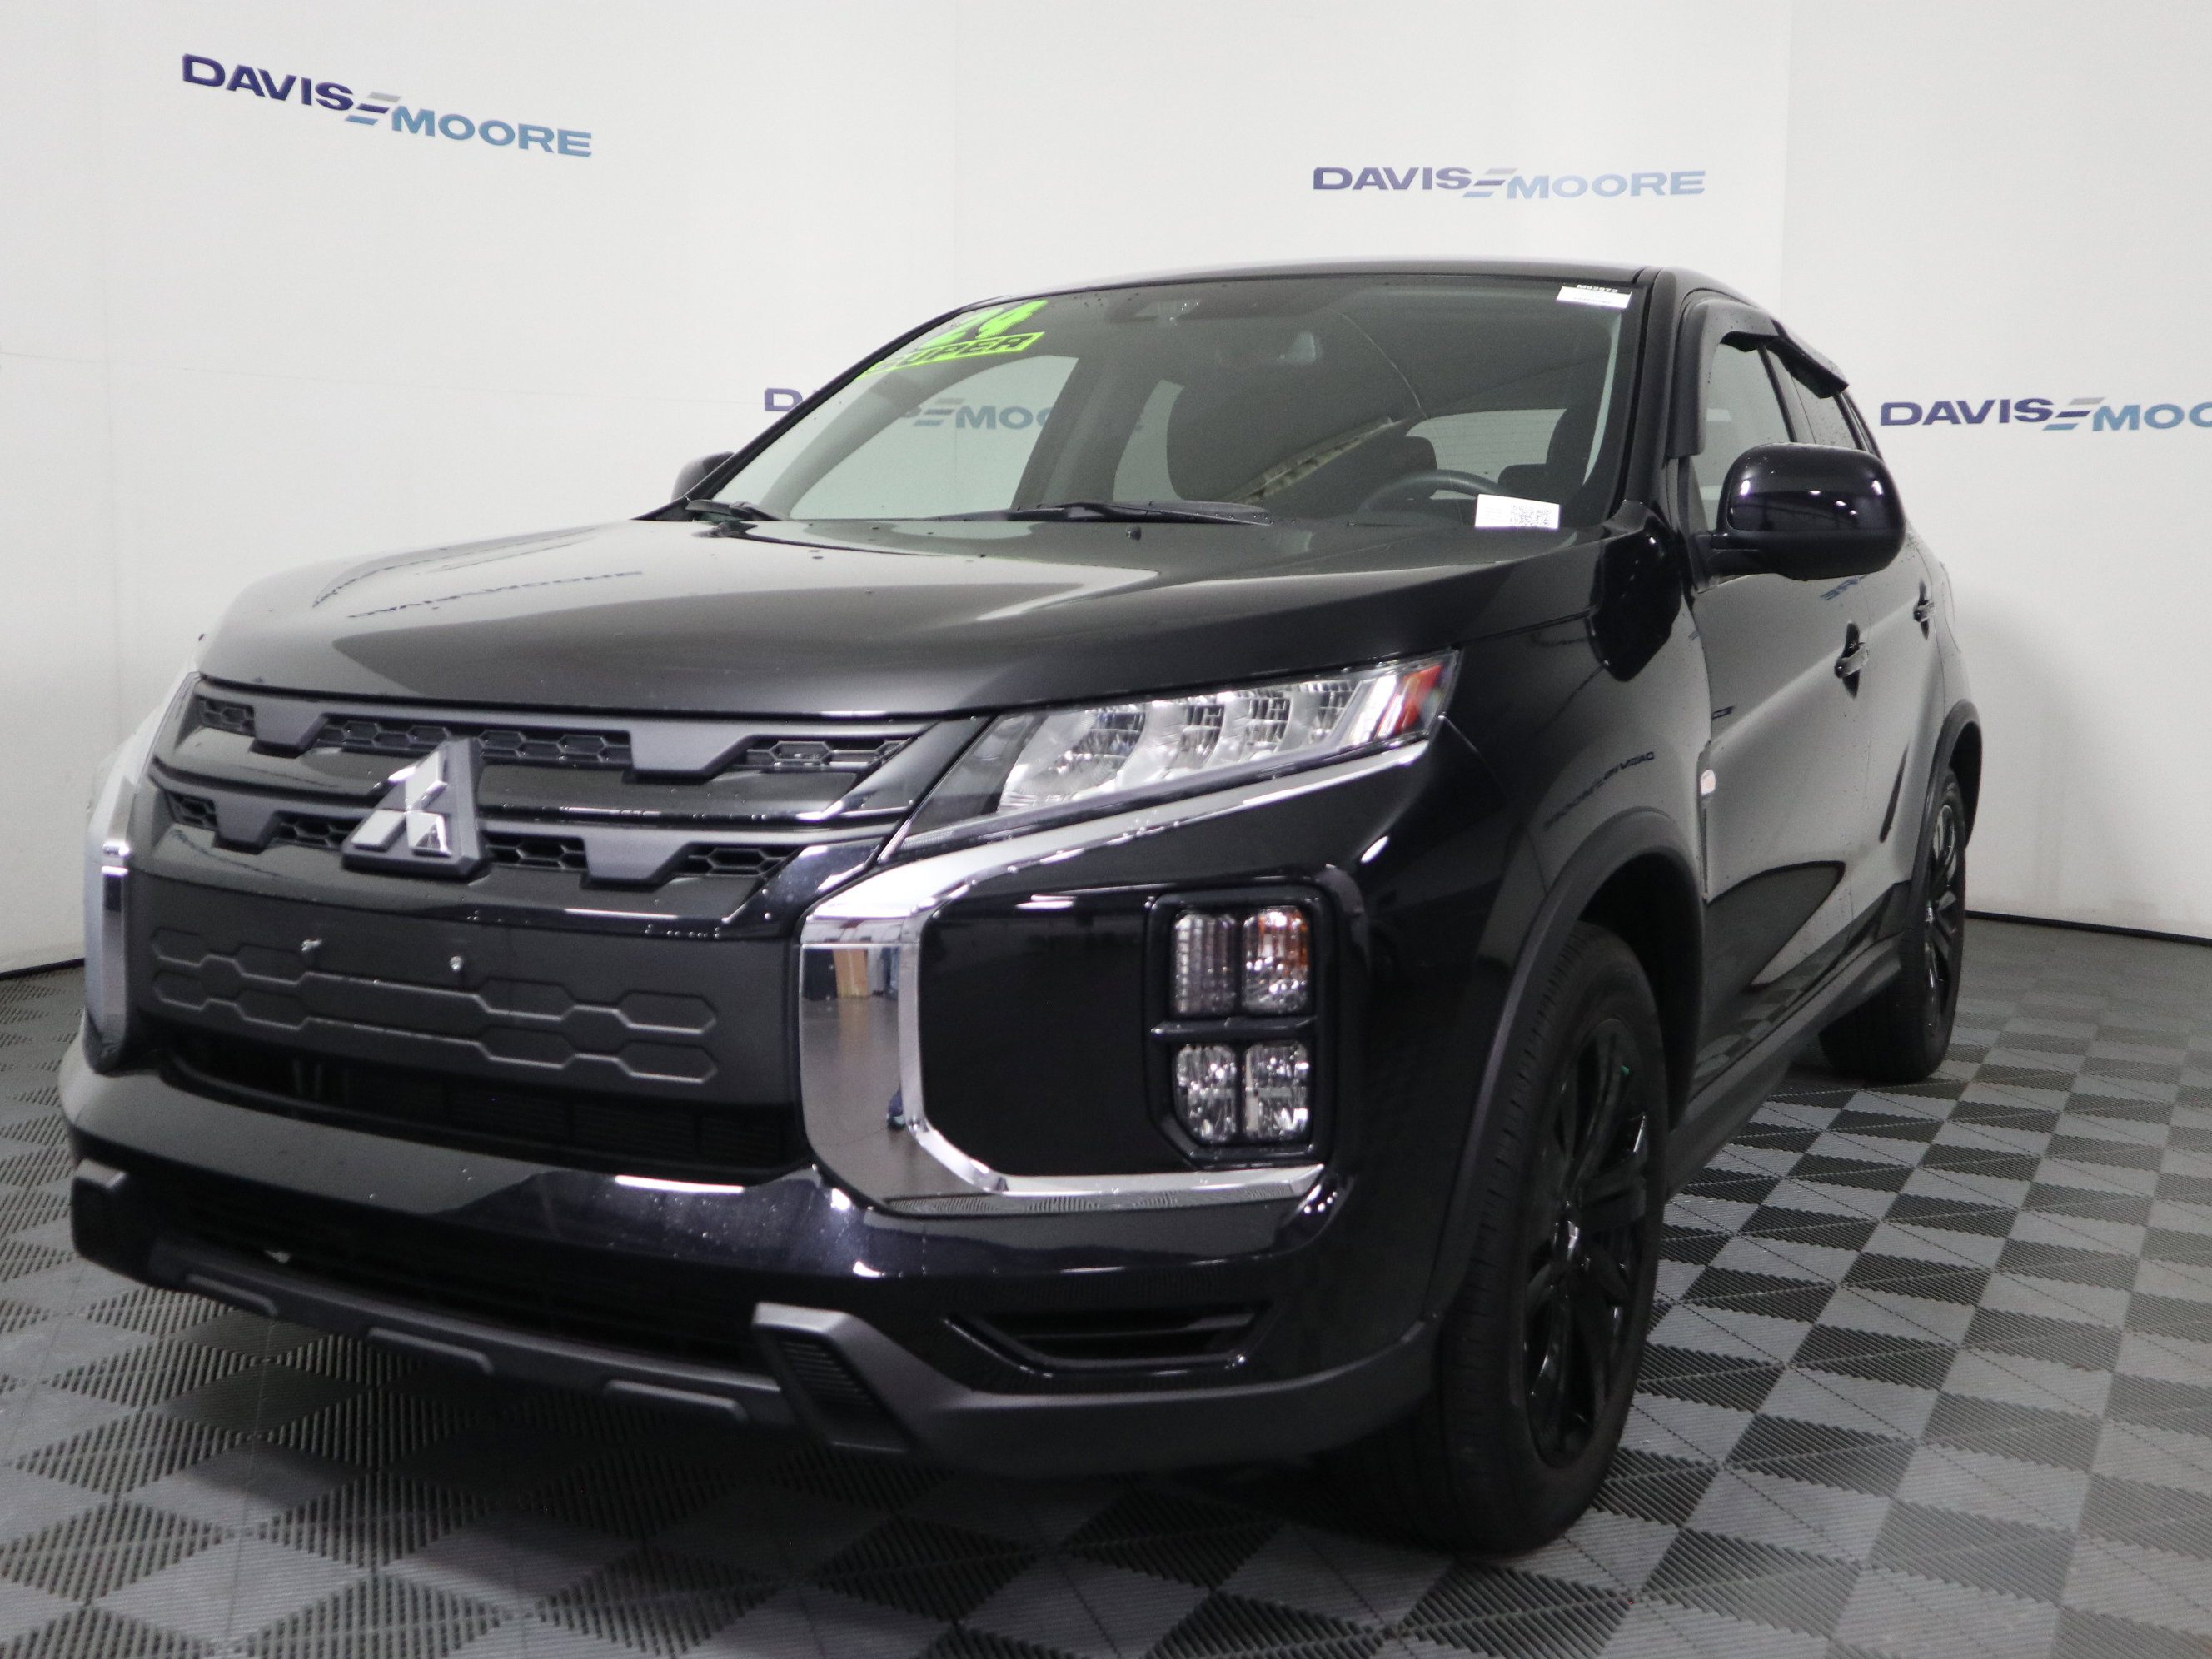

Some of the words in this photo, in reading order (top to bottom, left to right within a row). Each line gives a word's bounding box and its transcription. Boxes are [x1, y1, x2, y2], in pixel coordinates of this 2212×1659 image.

[182, 53, 354, 111] DAVIS
[391, 105, 592, 157] MOORE
[1313, 167, 1473, 190] DAVIS
[1506, 170, 1706, 199] MOORE
[1880, 397, 2054, 426] DAVIS
